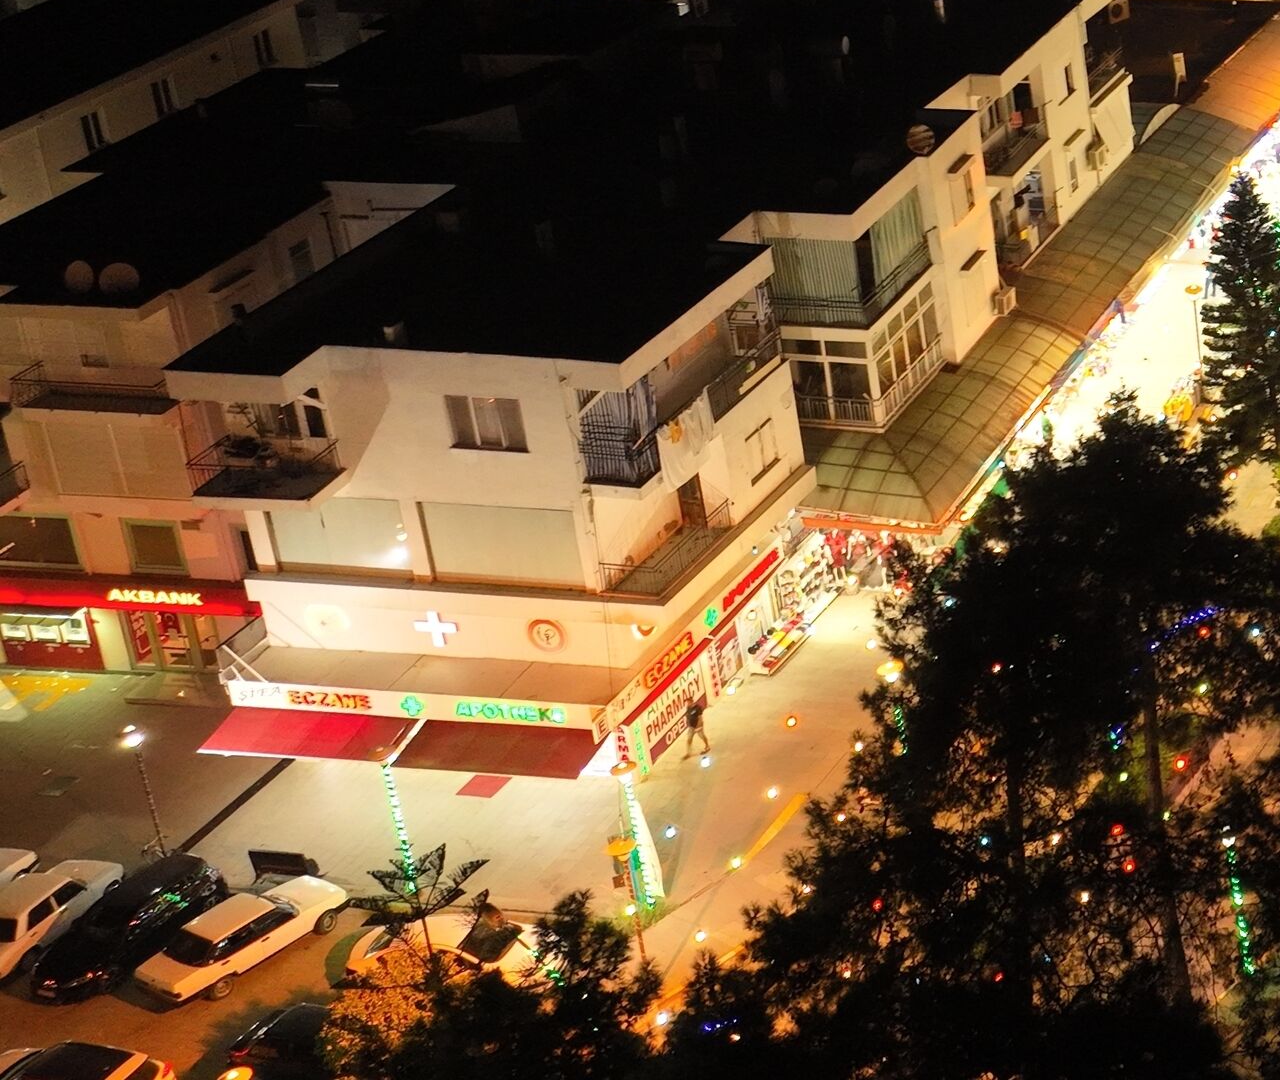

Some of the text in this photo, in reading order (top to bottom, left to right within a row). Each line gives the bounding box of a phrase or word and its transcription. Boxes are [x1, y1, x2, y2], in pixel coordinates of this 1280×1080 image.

[107, 588, 203, 606] AKBANK
[286, 689, 373, 711] ECZANE
[455, 701, 567, 724] APOTHEKE
[645, 673, 701, 743] PHARMACY
[665, 716, 688, 745] OPE
